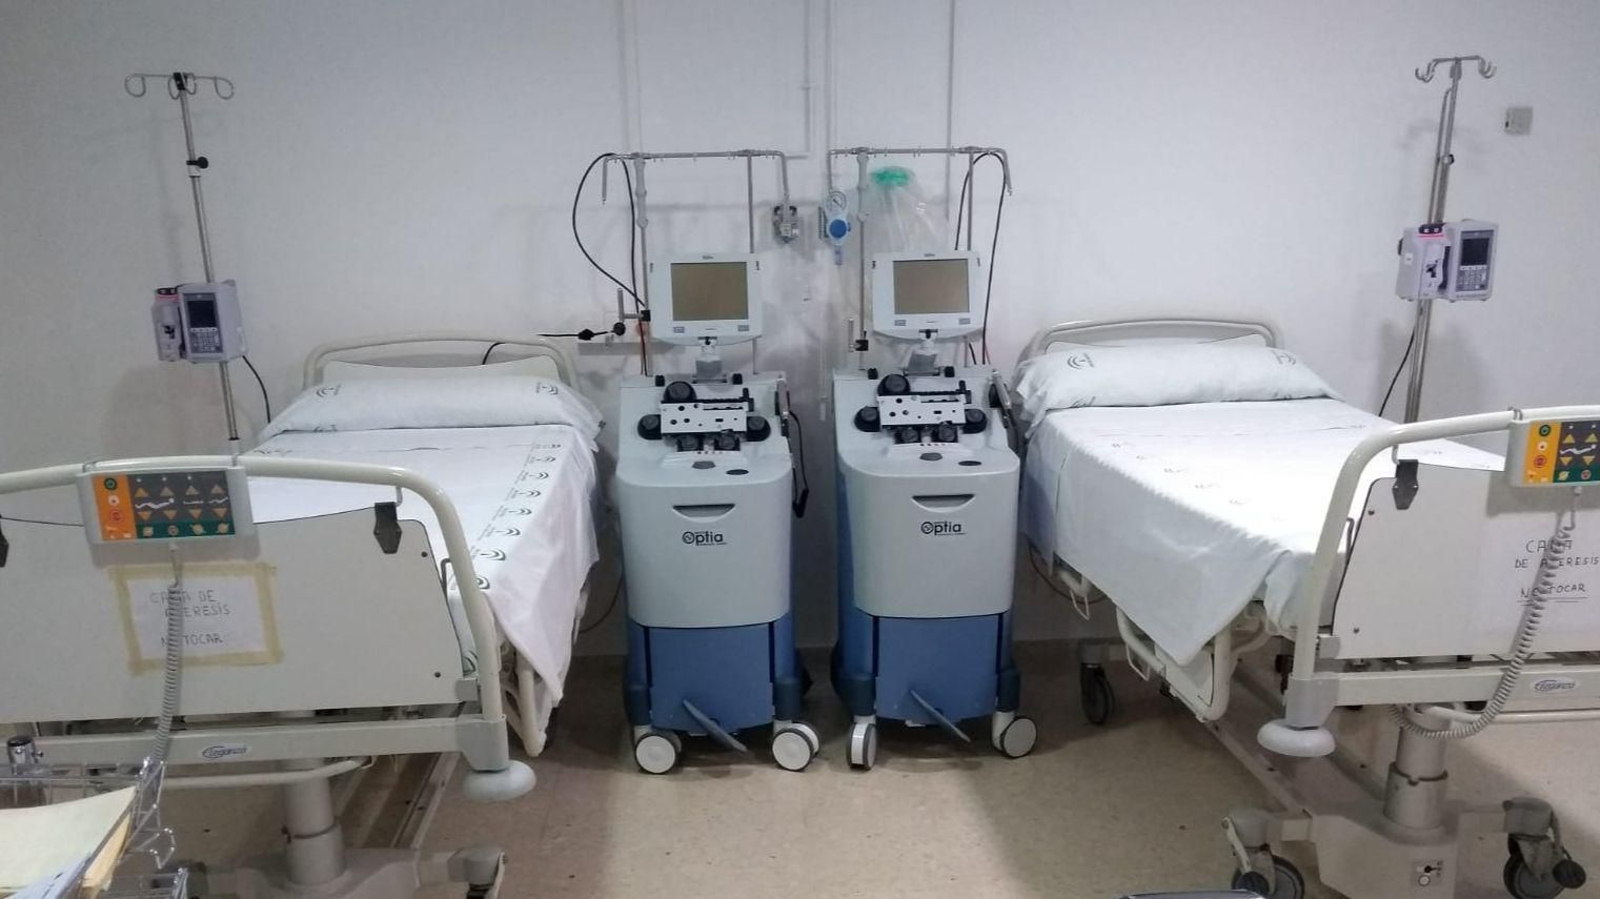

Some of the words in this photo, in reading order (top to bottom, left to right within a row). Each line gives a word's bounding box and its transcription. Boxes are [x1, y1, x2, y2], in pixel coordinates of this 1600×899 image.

[921, 521, 962, 536] Optia
[682, 530, 724, 546] Optia
[1525, 539, 1573, 553] CAA
[1515, 558, 1528, 569] DE
[1540, 556, 1600, 568] AERESIS
[198, 589, 217, 603] DE
[1547, 583, 1586, 595] TOCAR
[182, 632, 224, 646] TOCAR
